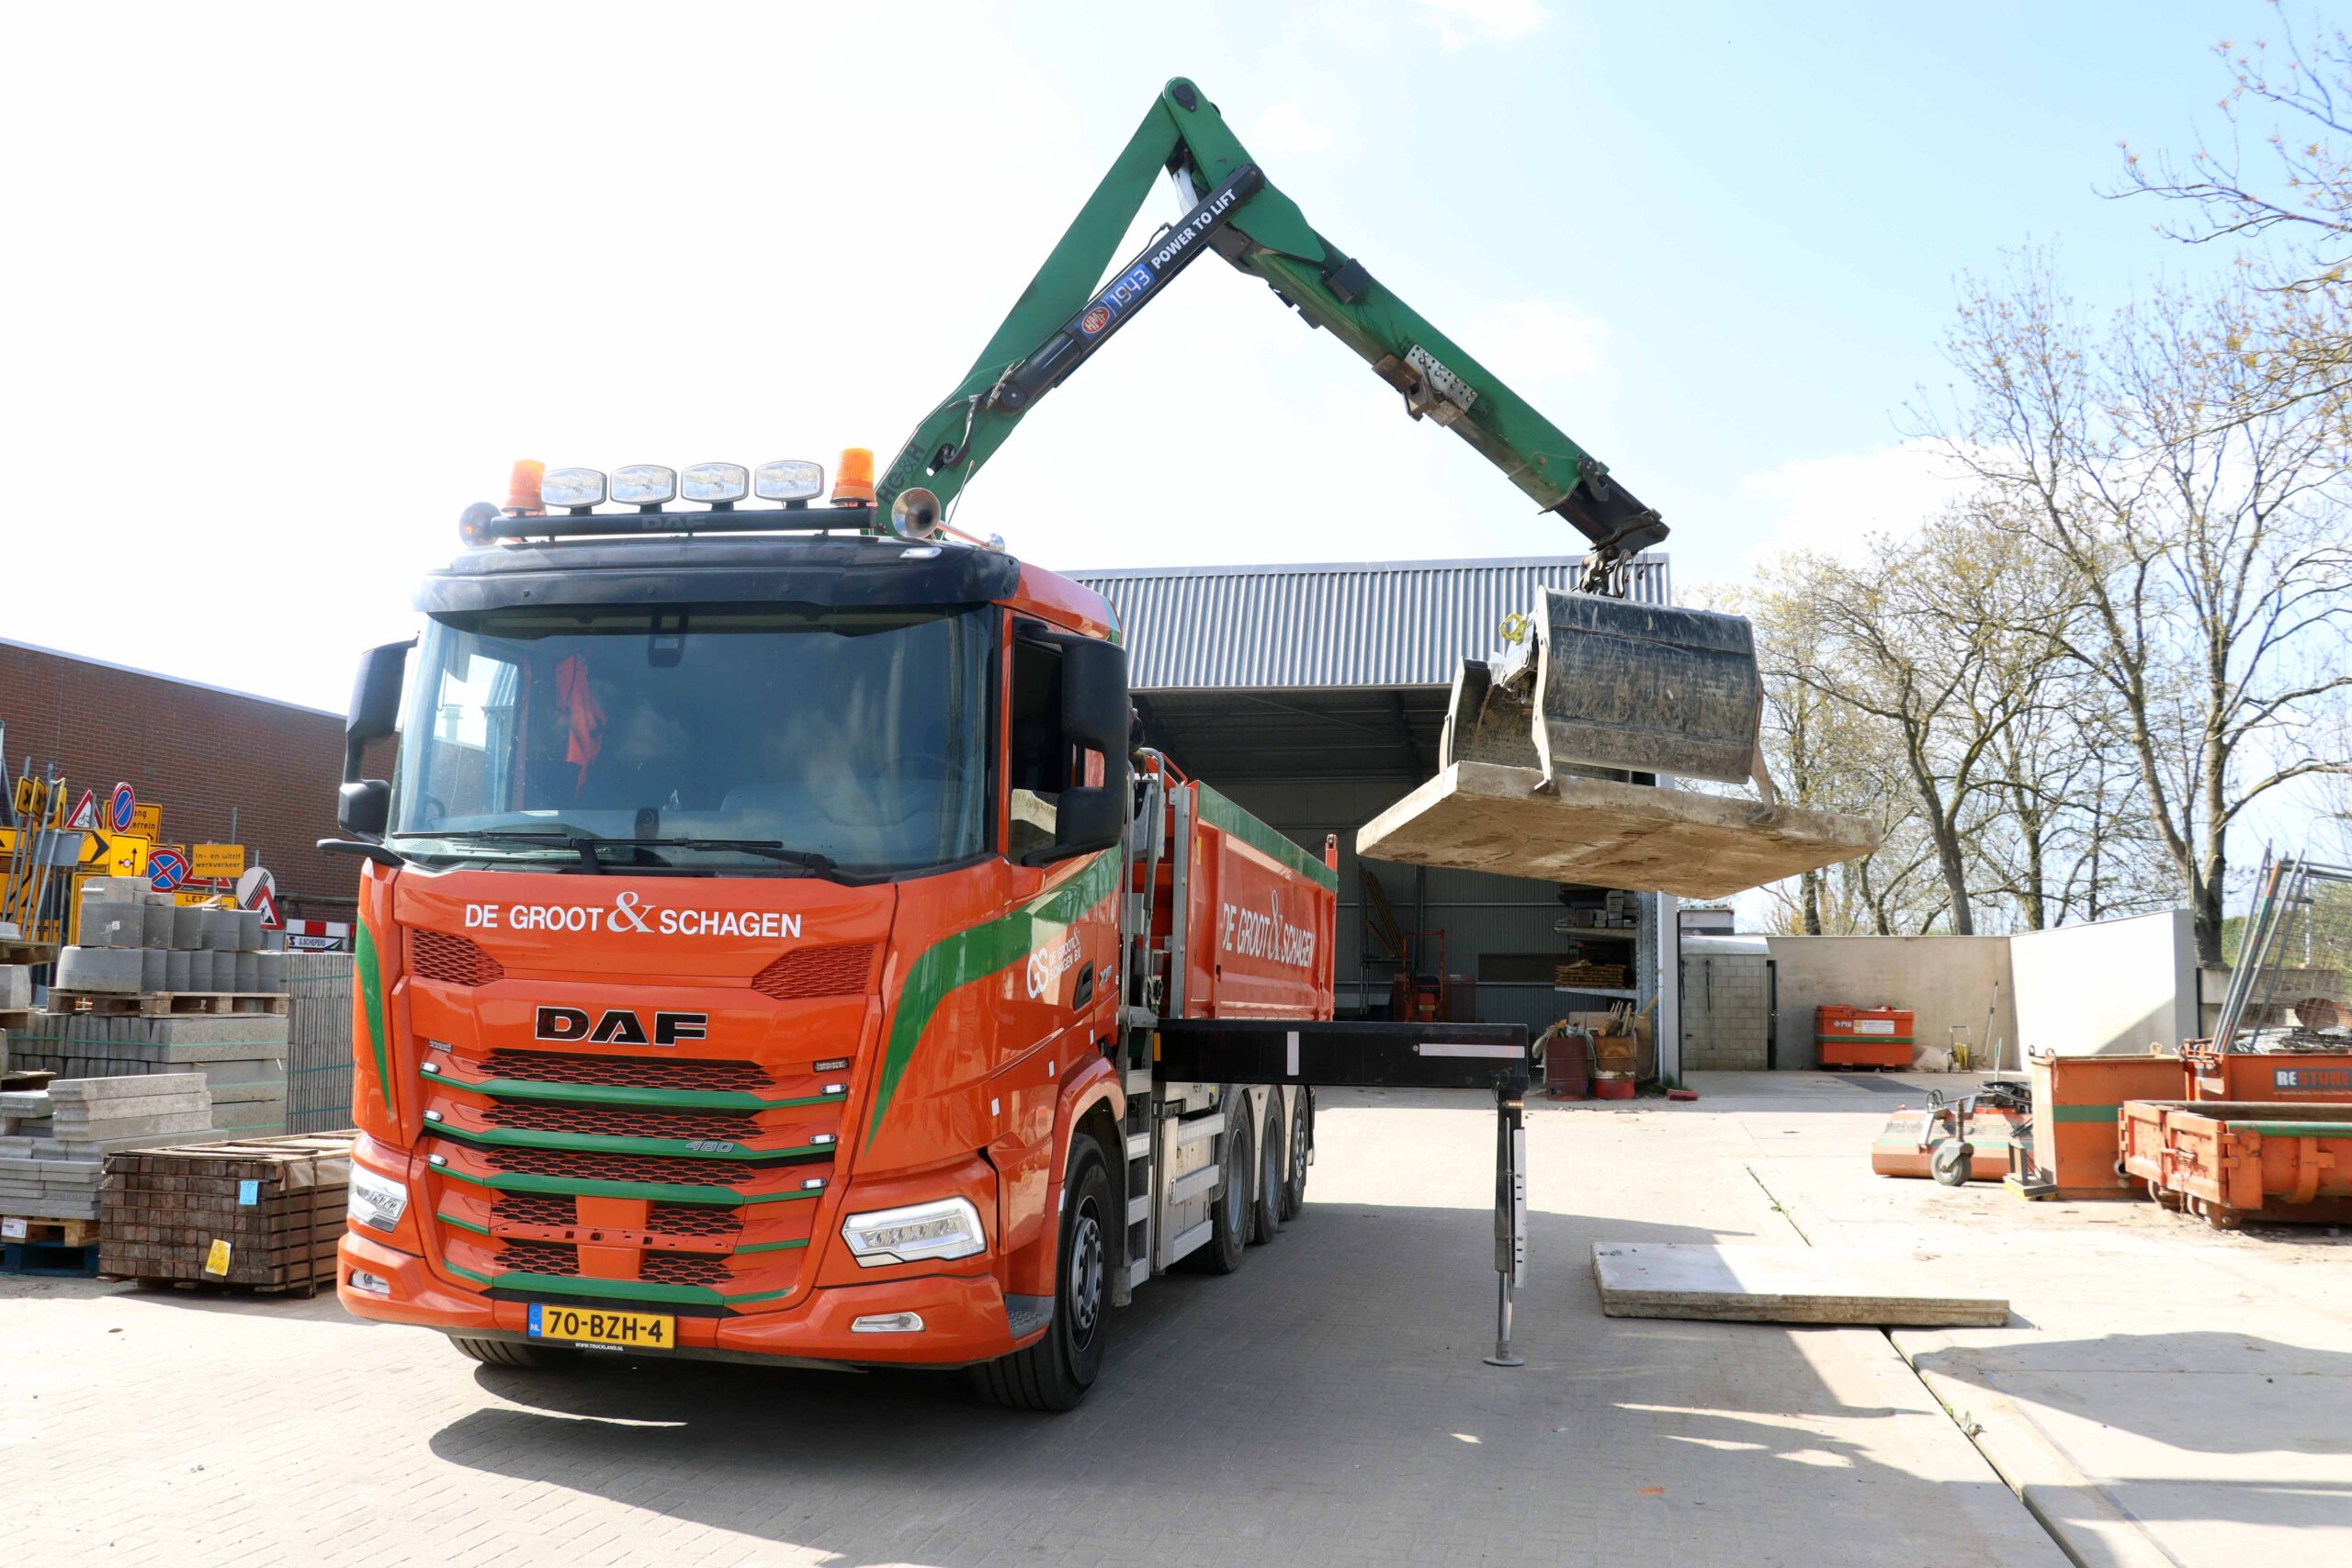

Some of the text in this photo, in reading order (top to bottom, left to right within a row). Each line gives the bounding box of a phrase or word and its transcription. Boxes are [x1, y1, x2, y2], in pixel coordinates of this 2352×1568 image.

[1150, 188, 1237, 270] POWER TO LIFT
[1110, 269, 1150, 307] 1943
[641, 515, 706, 530] DAF
[186, 895, 203, 903] LET
[464, 891, 802, 938] DE GROOT & SCHAGEN
[1222, 888, 1316, 968] DE GROOT & SCHAGEN
[1049, 951, 1057, 965] DE
[1057, 937, 1074, 960] GROOT
[1049, 953, 1073, 981] SCHAGEN
[1099, 965, 1113, 987] XF
[535, 1005, 708, 1046] DAF
[685, 1141, 734, 1153] 480
[530, 1311, 663, 1343] NL 70-BZH-4
[575, 1342, 624, 1351] WWW.TRUCKLAND.NL
